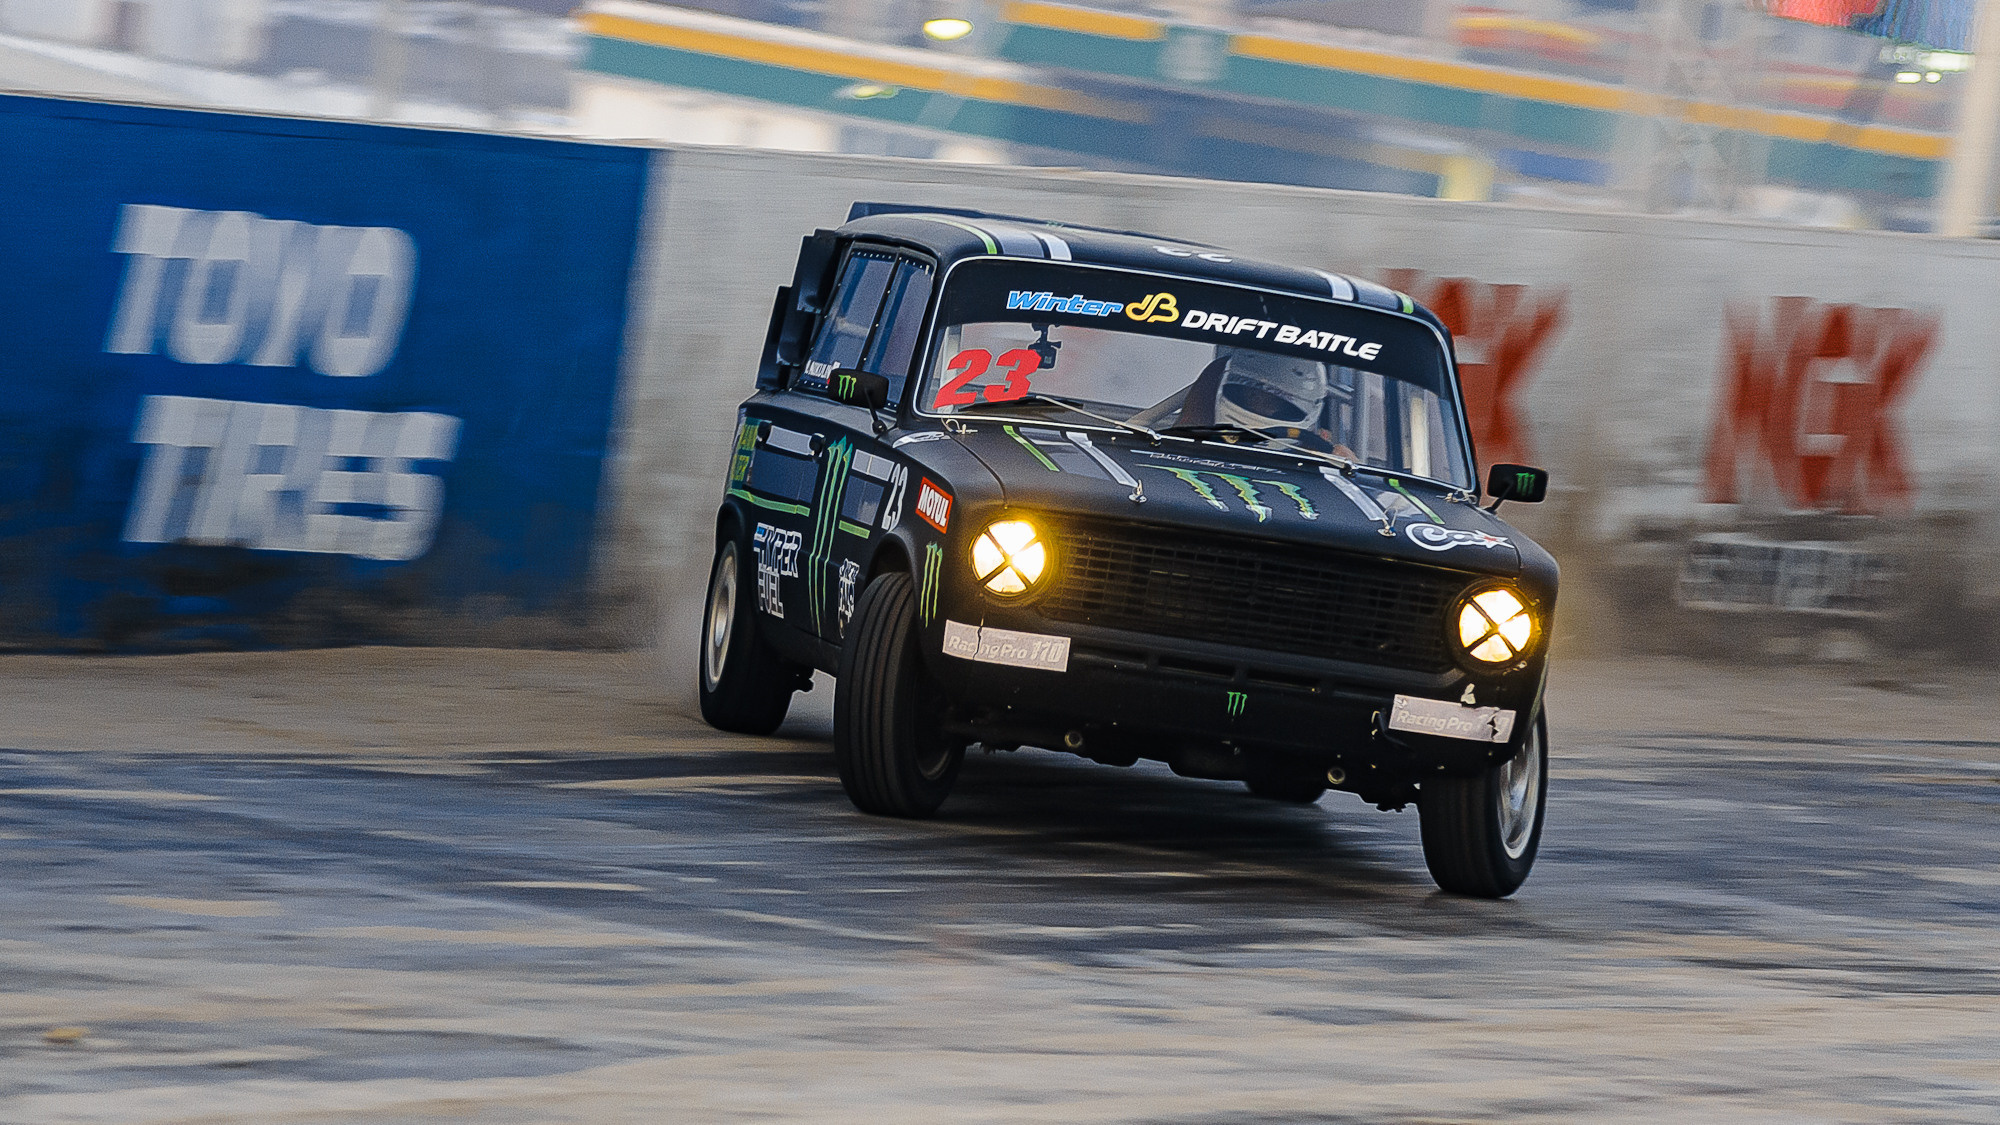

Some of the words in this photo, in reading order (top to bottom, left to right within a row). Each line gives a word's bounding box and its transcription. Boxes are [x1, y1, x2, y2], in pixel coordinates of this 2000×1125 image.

[103, 204, 422, 377] TOYO
[1006, 290, 1123, 317] Winter
[1181, 309, 1277, 340] DRIFT
[1275, 324, 1383, 362] BATTLE
[933, 348, 1042, 409] 23
[1702, 296, 1940, 517] NGK
[119, 394, 464, 562] TIRES
[881, 463, 908, 533] 23
[917, 483, 950, 528] MOTUL
